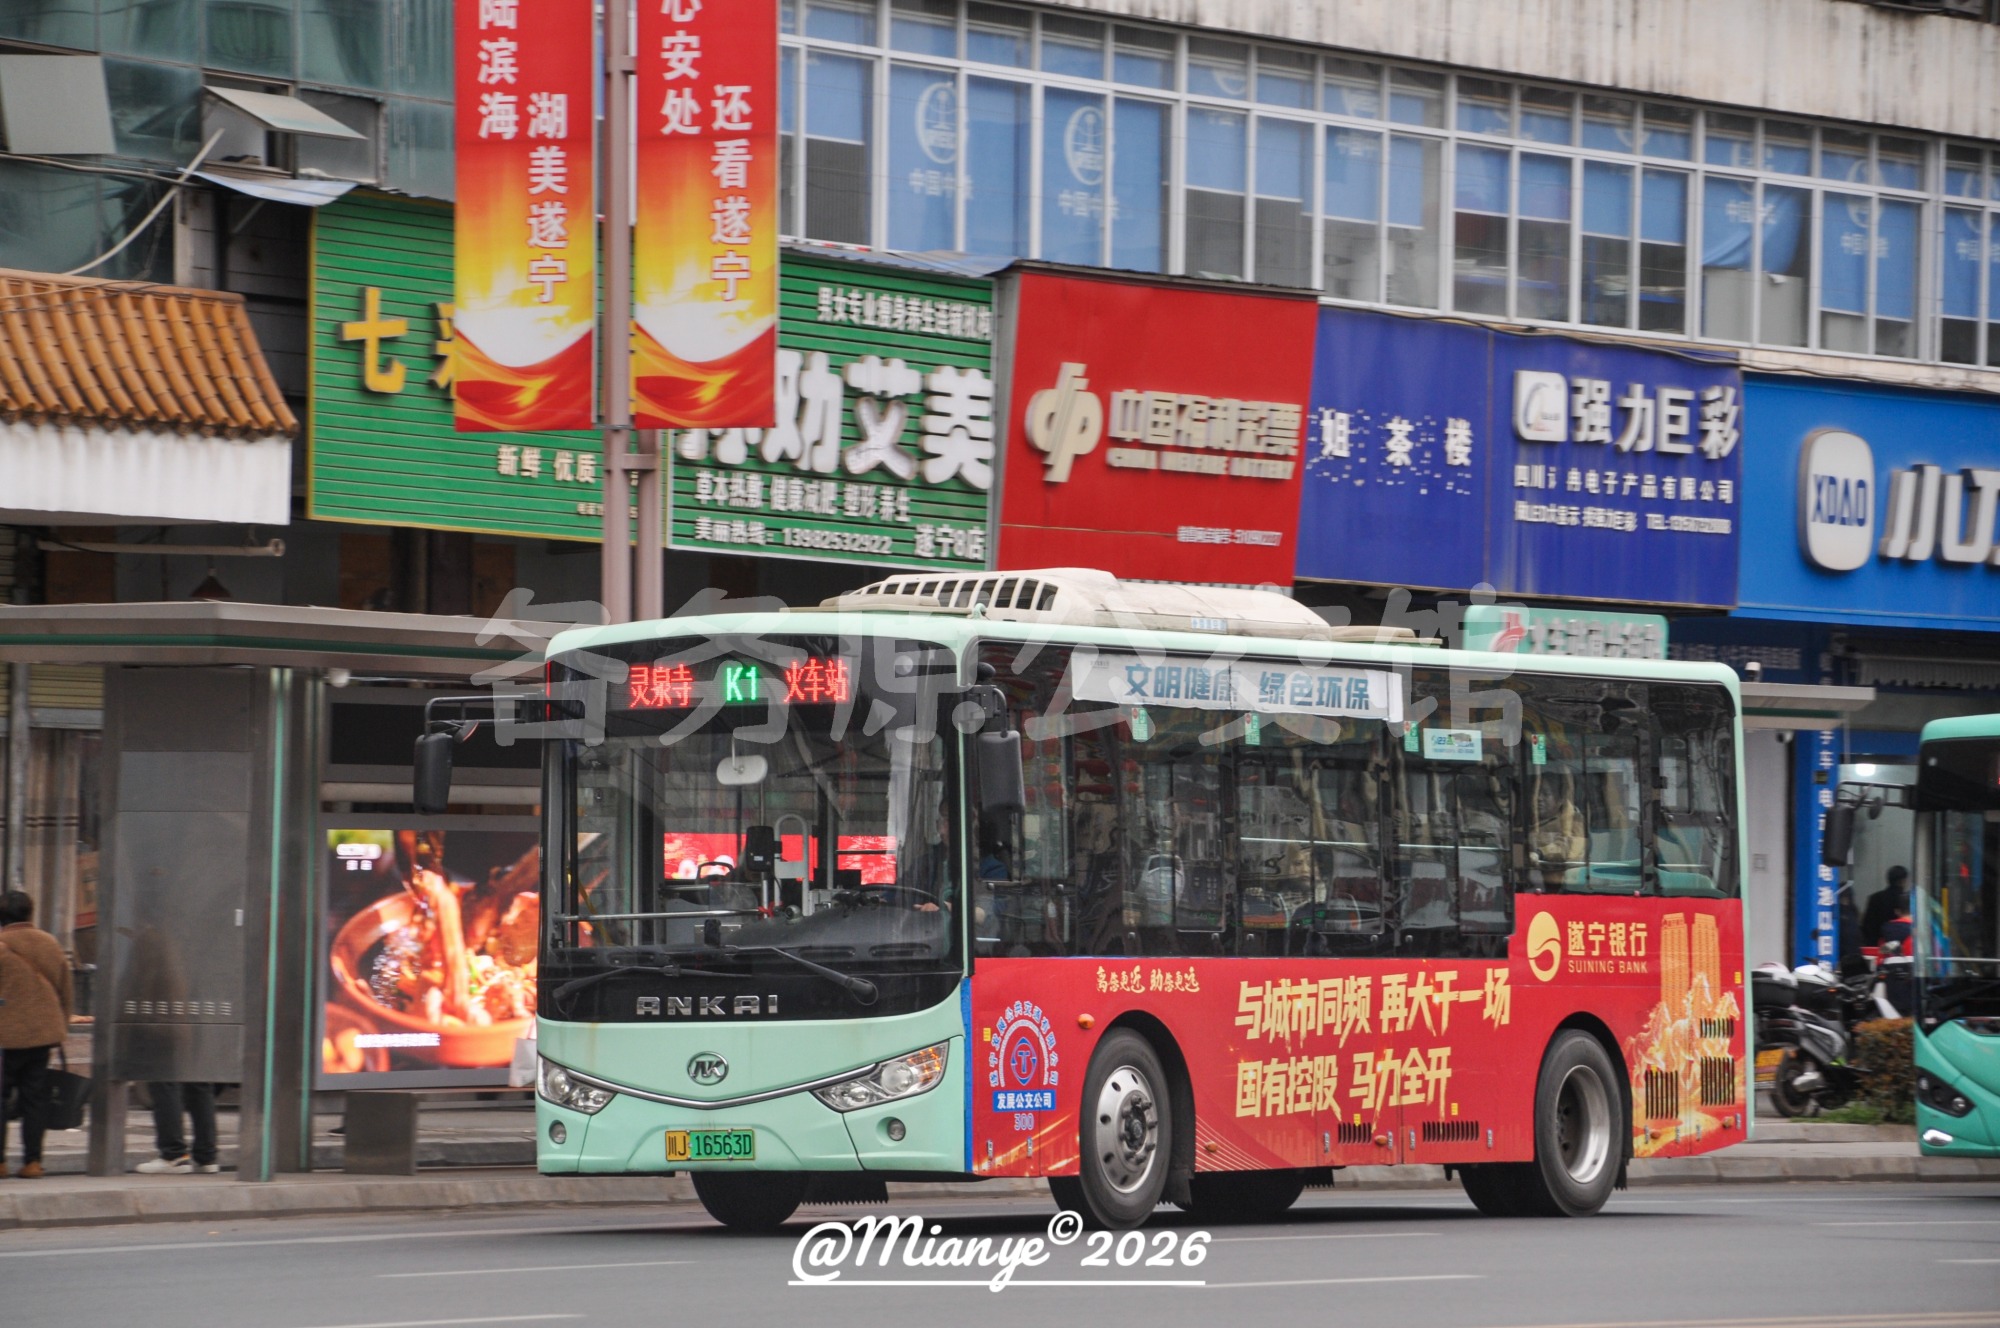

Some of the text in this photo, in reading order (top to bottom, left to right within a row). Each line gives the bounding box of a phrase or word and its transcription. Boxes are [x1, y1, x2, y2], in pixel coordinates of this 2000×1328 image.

[527, 92, 568, 303] 湖美遂宁
[711, 84, 752, 302] 还看遂宁
[1571, 377, 1740, 460] 强力巨彩
[497, 444, 541, 478] 新鲜
[554, 450, 597, 483] 优质
[1811, 473, 1868, 528] XDAO
[629, 657, 849, 708] 灵泉寺 K1 火车站
[1124, 663, 1371, 710] 文明健康 绿色环保
[1567, 921, 1648, 957] 遂宁银行
[1568, 959, 1649, 974] SUINING BANK
[636, 994, 779, 1016] ANKAI
[1235, 968, 1512, 1054] 与城市同频 再大干一场
[996, 1092, 1053, 1109] 发展公交公司
[1235, 1046, 1453, 1128] 国有控股 马力全开
[1013, 1112, 1035, 1131] 300
